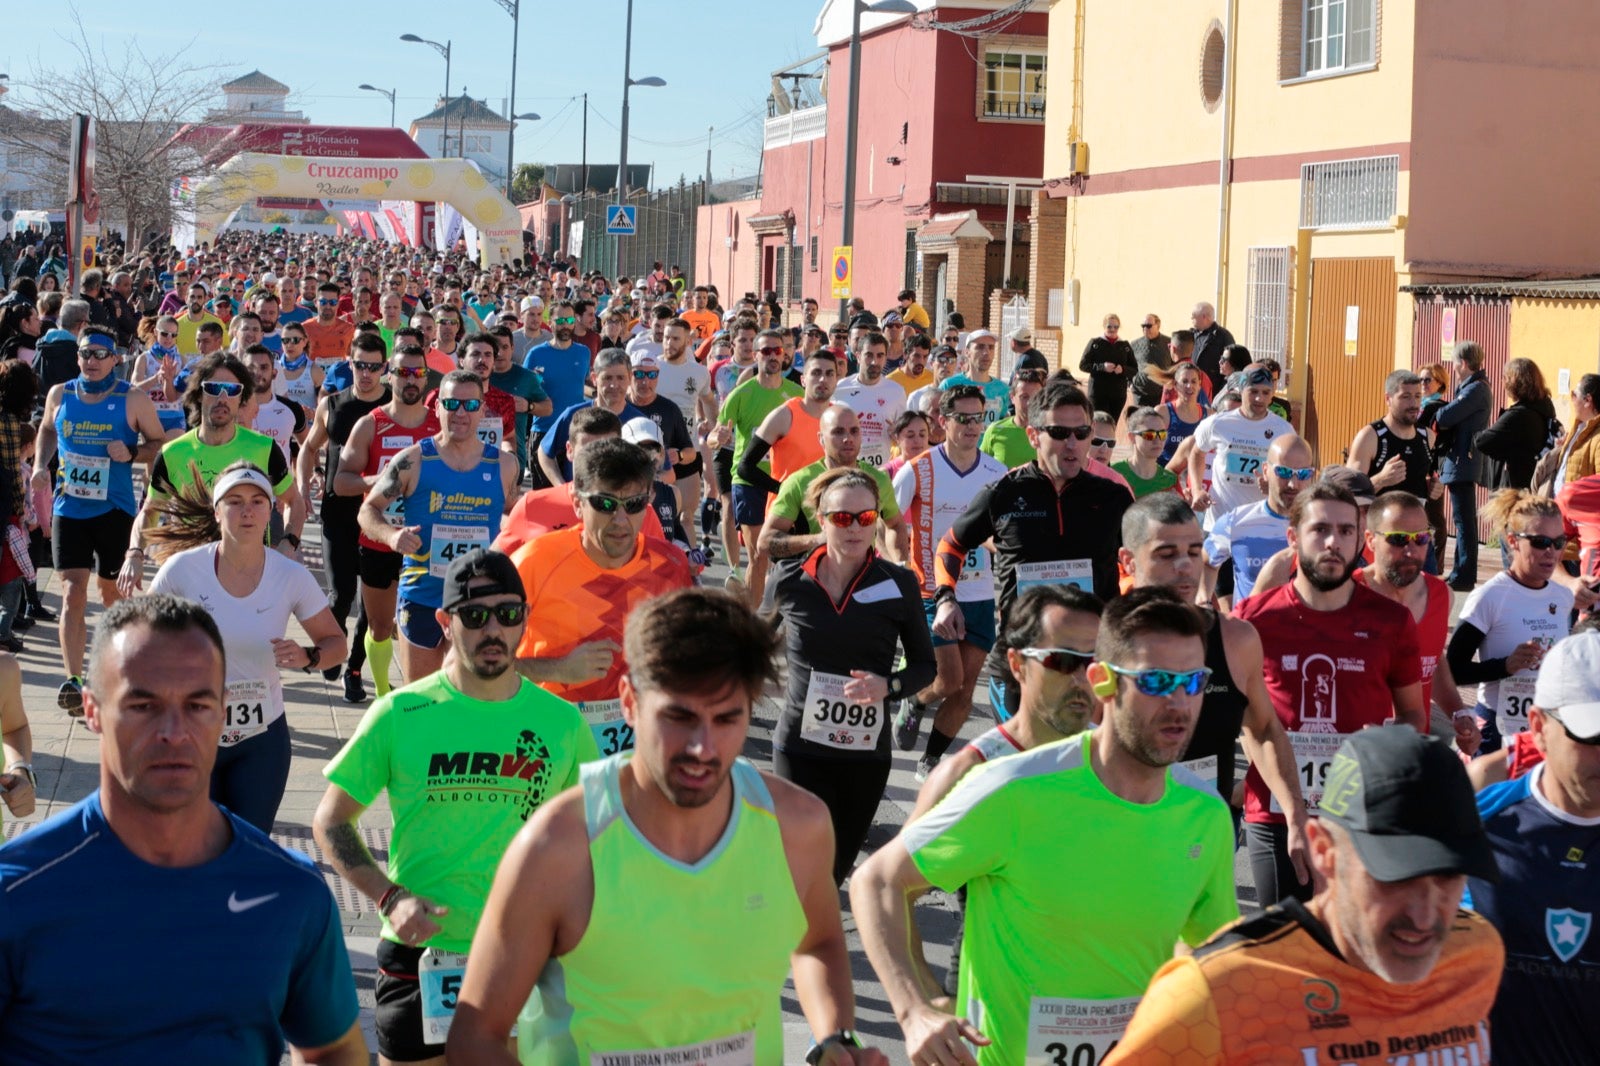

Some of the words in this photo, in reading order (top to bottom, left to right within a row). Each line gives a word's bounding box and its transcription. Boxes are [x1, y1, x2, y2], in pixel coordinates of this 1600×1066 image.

[306, 133, 359, 145] Diputación
[306, 147, 318, 155] de
[319, 147, 359, 157] Granada
[308, 162, 399, 181] Cruzcampo
[315, 182, 360, 195] Radler
[75, 421, 113, 431] olimpo
[1240, 457, 1260, 473] 72
[70, 467, 101, 486] 444
[447, 492, 492, 507] olimpo
[814, 698, 877, 728] 3098
[427, 777, 498, 787] RUNNING
[426, 792, 521, 806] ALBOLOTE
[1065, 1004, 1088, 1016] GRAN
[1090, 1004, 1118, 1016] PREMIO
[1119, 1004, 1127, 1014] DE
[1055, 1016, 1098, 1026] DIPUTACIÓN
[1100, 1017, 1108, 1026] DE
[1328, 1039, 1381, 1061] Club
[1387, 1023, 1476, 1055] Deportivo
[602, 1053, 631, 1066] XXXIII
[633, 1053, 661, 1066] GRAN
[664, 1050, 700, 1065] PREMIO
[702, 1046, 713, 1059] DE
[716, 1036, 746, 1054] FONDO
